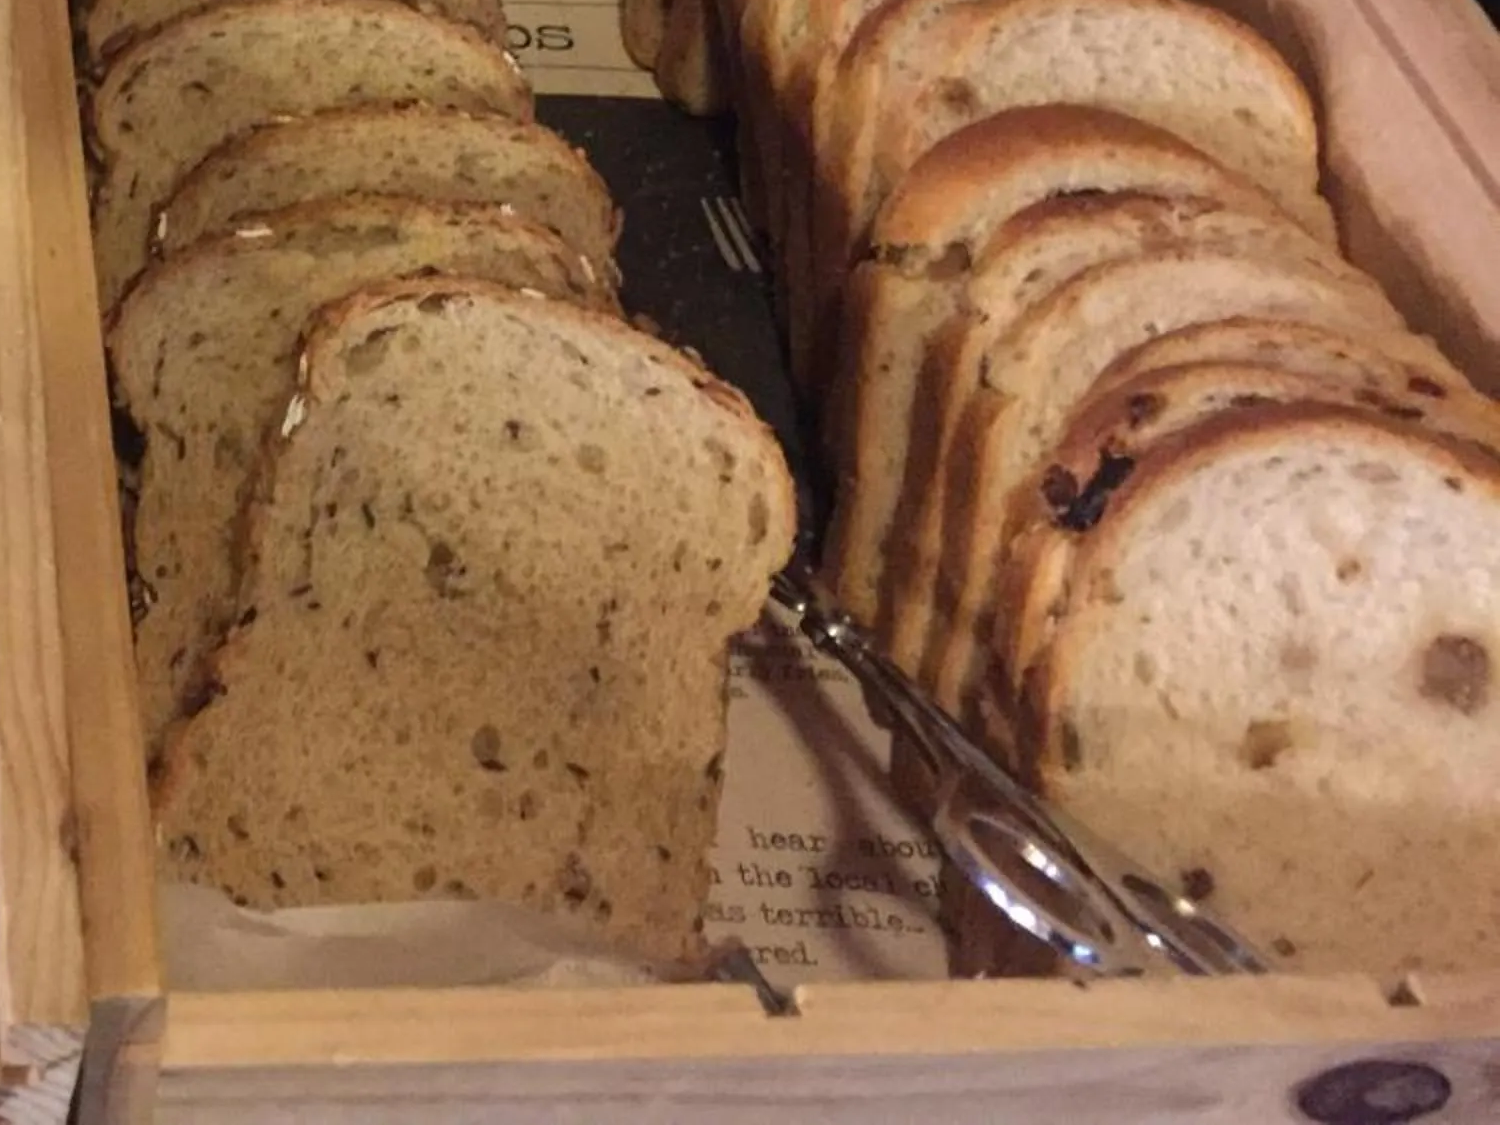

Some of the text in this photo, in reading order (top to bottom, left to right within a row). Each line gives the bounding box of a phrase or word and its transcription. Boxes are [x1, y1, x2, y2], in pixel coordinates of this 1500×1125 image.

[745, 825, 936, 858] hear abou
[738, 862, 792, 889] the
